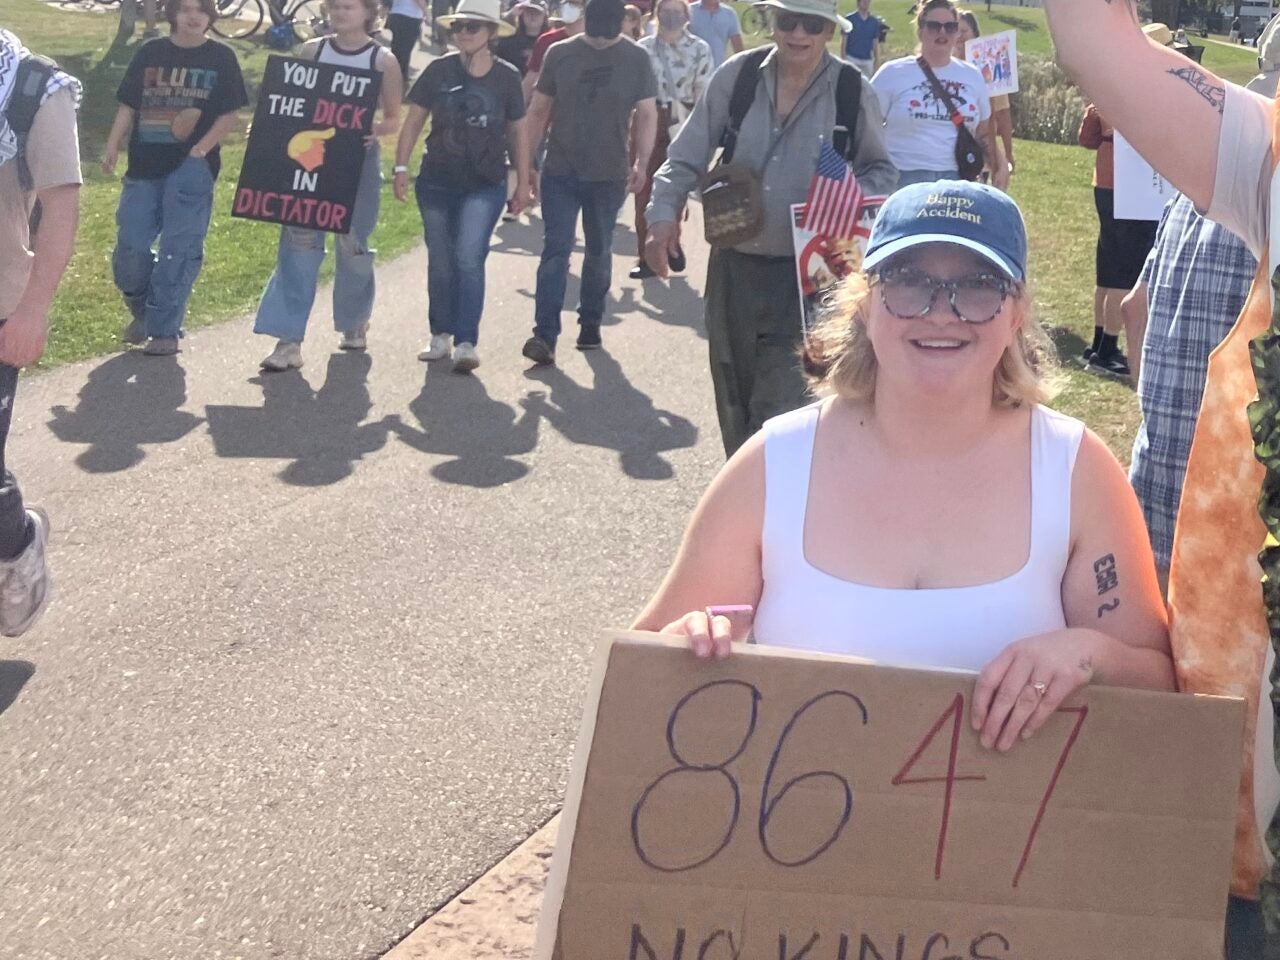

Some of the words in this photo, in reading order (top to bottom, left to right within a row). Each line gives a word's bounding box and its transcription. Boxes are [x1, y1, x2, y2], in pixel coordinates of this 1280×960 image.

[283, 61, 319, 90] YOU
[331, 71, 371, 98] PUT
[268, 94, 306, 117] THE
[312, 97, 368, 130] DICK
[292, 169, 318, 192] IN
[235, 188, 348, 230] DICTATOR
[927, 193, 975, 209] Happy
[916, 207, 982, 225] Accident
